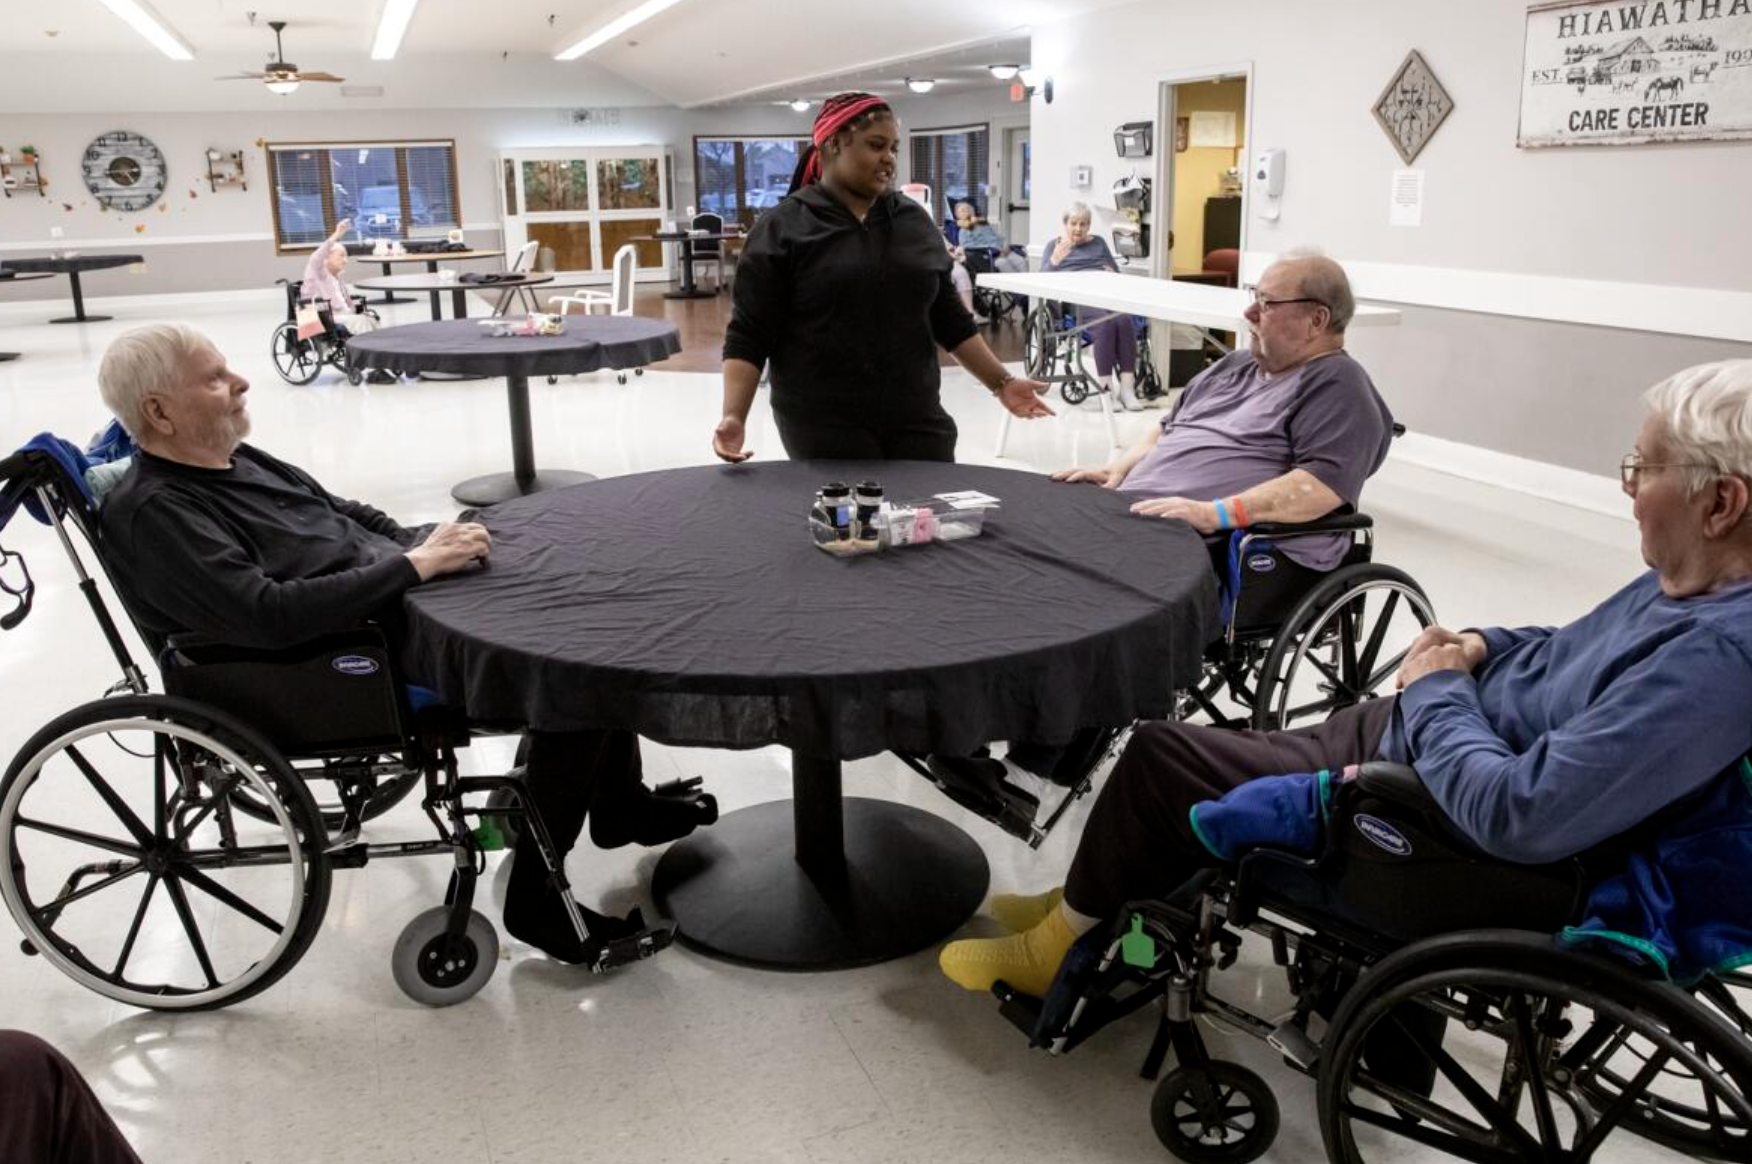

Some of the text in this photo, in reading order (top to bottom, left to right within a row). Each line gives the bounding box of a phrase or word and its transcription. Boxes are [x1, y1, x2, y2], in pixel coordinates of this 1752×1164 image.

[1557, 0, 1751, 38] HIAWATHA
[1532, 69, 1563, 82] EST.
[1568, 102, 1709, 131] CARE CENTER
